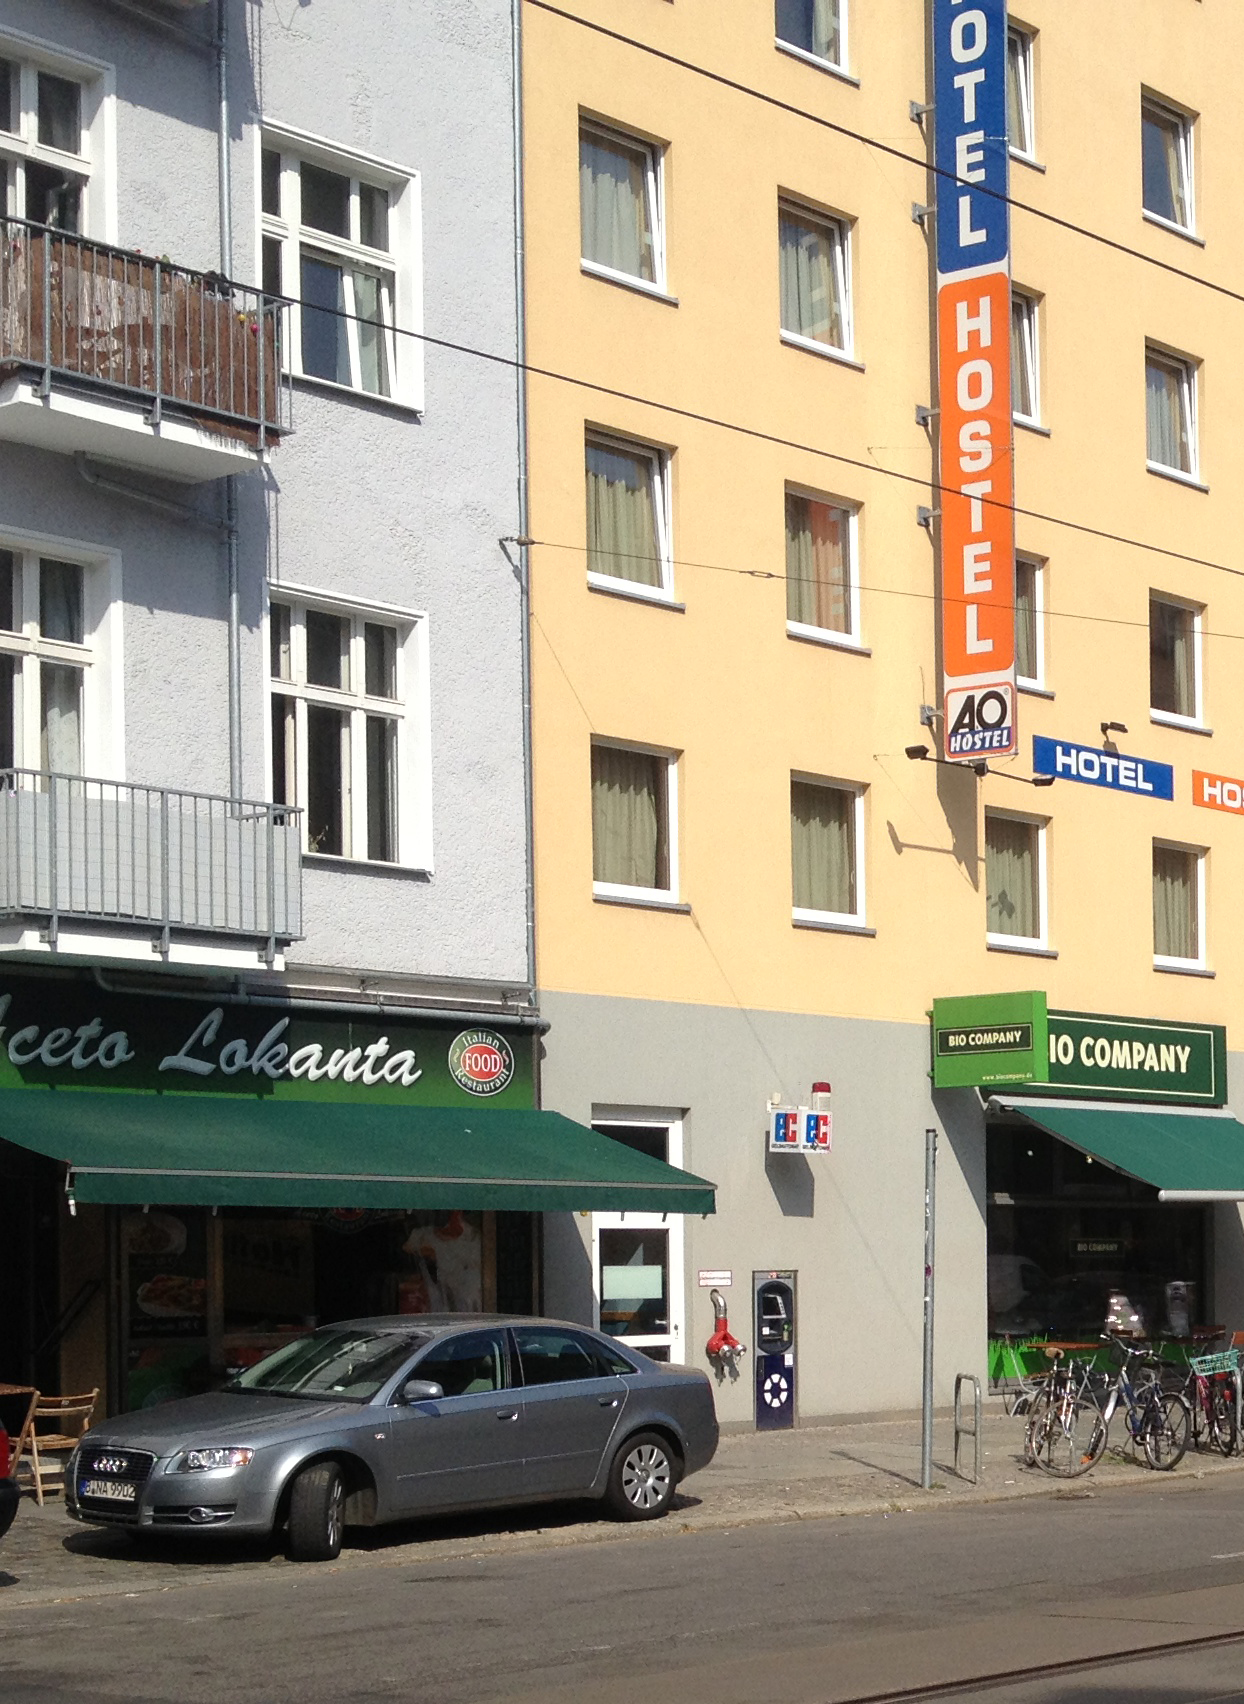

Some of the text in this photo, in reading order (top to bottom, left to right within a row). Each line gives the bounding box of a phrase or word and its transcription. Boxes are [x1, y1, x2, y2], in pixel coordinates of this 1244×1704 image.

[951, 0, 989, 248] OTEL
[956, 295, 994, 655] HOSTEL
[950, 729, 1010, 752] HOSTEL
[1055, 745, 1154, 791] HOTEL
[0, 993, 423, 1087] ceto Lokanta
[462, 1032, 500, 1049] Italian
[948, 1030, 1022, 1047] BIO COMPANY
[1049, 1034, 1191, 1074] IO COMPANY
[464, 1052, 501, 1073] FOOD
[455, 1068, 510, 1092] Restaurant
